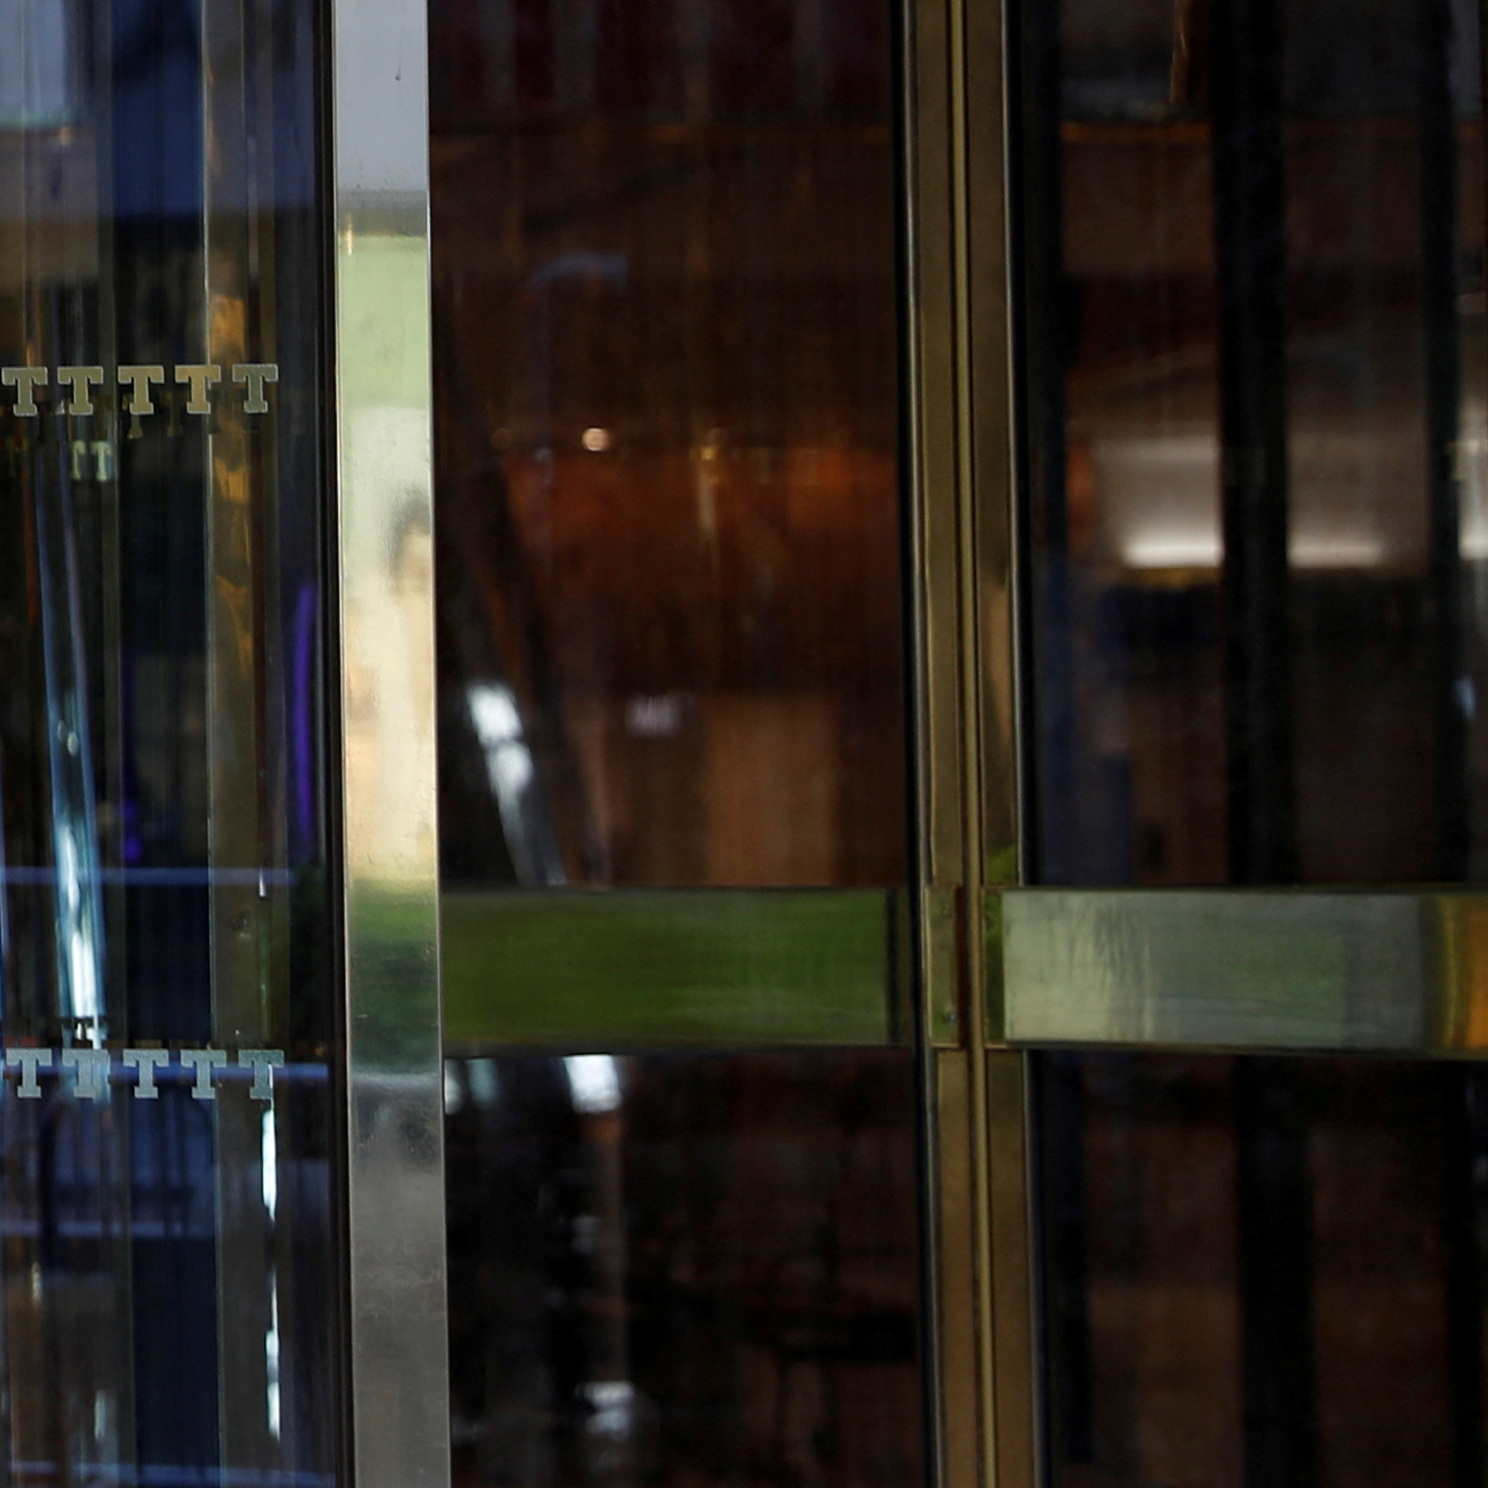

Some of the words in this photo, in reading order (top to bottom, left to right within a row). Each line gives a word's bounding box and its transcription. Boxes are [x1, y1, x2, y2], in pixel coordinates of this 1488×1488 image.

[1, 365, 48, 415] T
[58, 365, 104, 415] T
[118, 364, 164, 414] T
[174, 364, 221, 414] T
[232, 364, 278, 414] T
[6, 1048, 52, 1099] T
[62, 1048, 108, 1099] T
[123, 1048, 170, 1099] T
[180, 1049, 226, 1099] T
[238, 1049, 284, 1099] T
